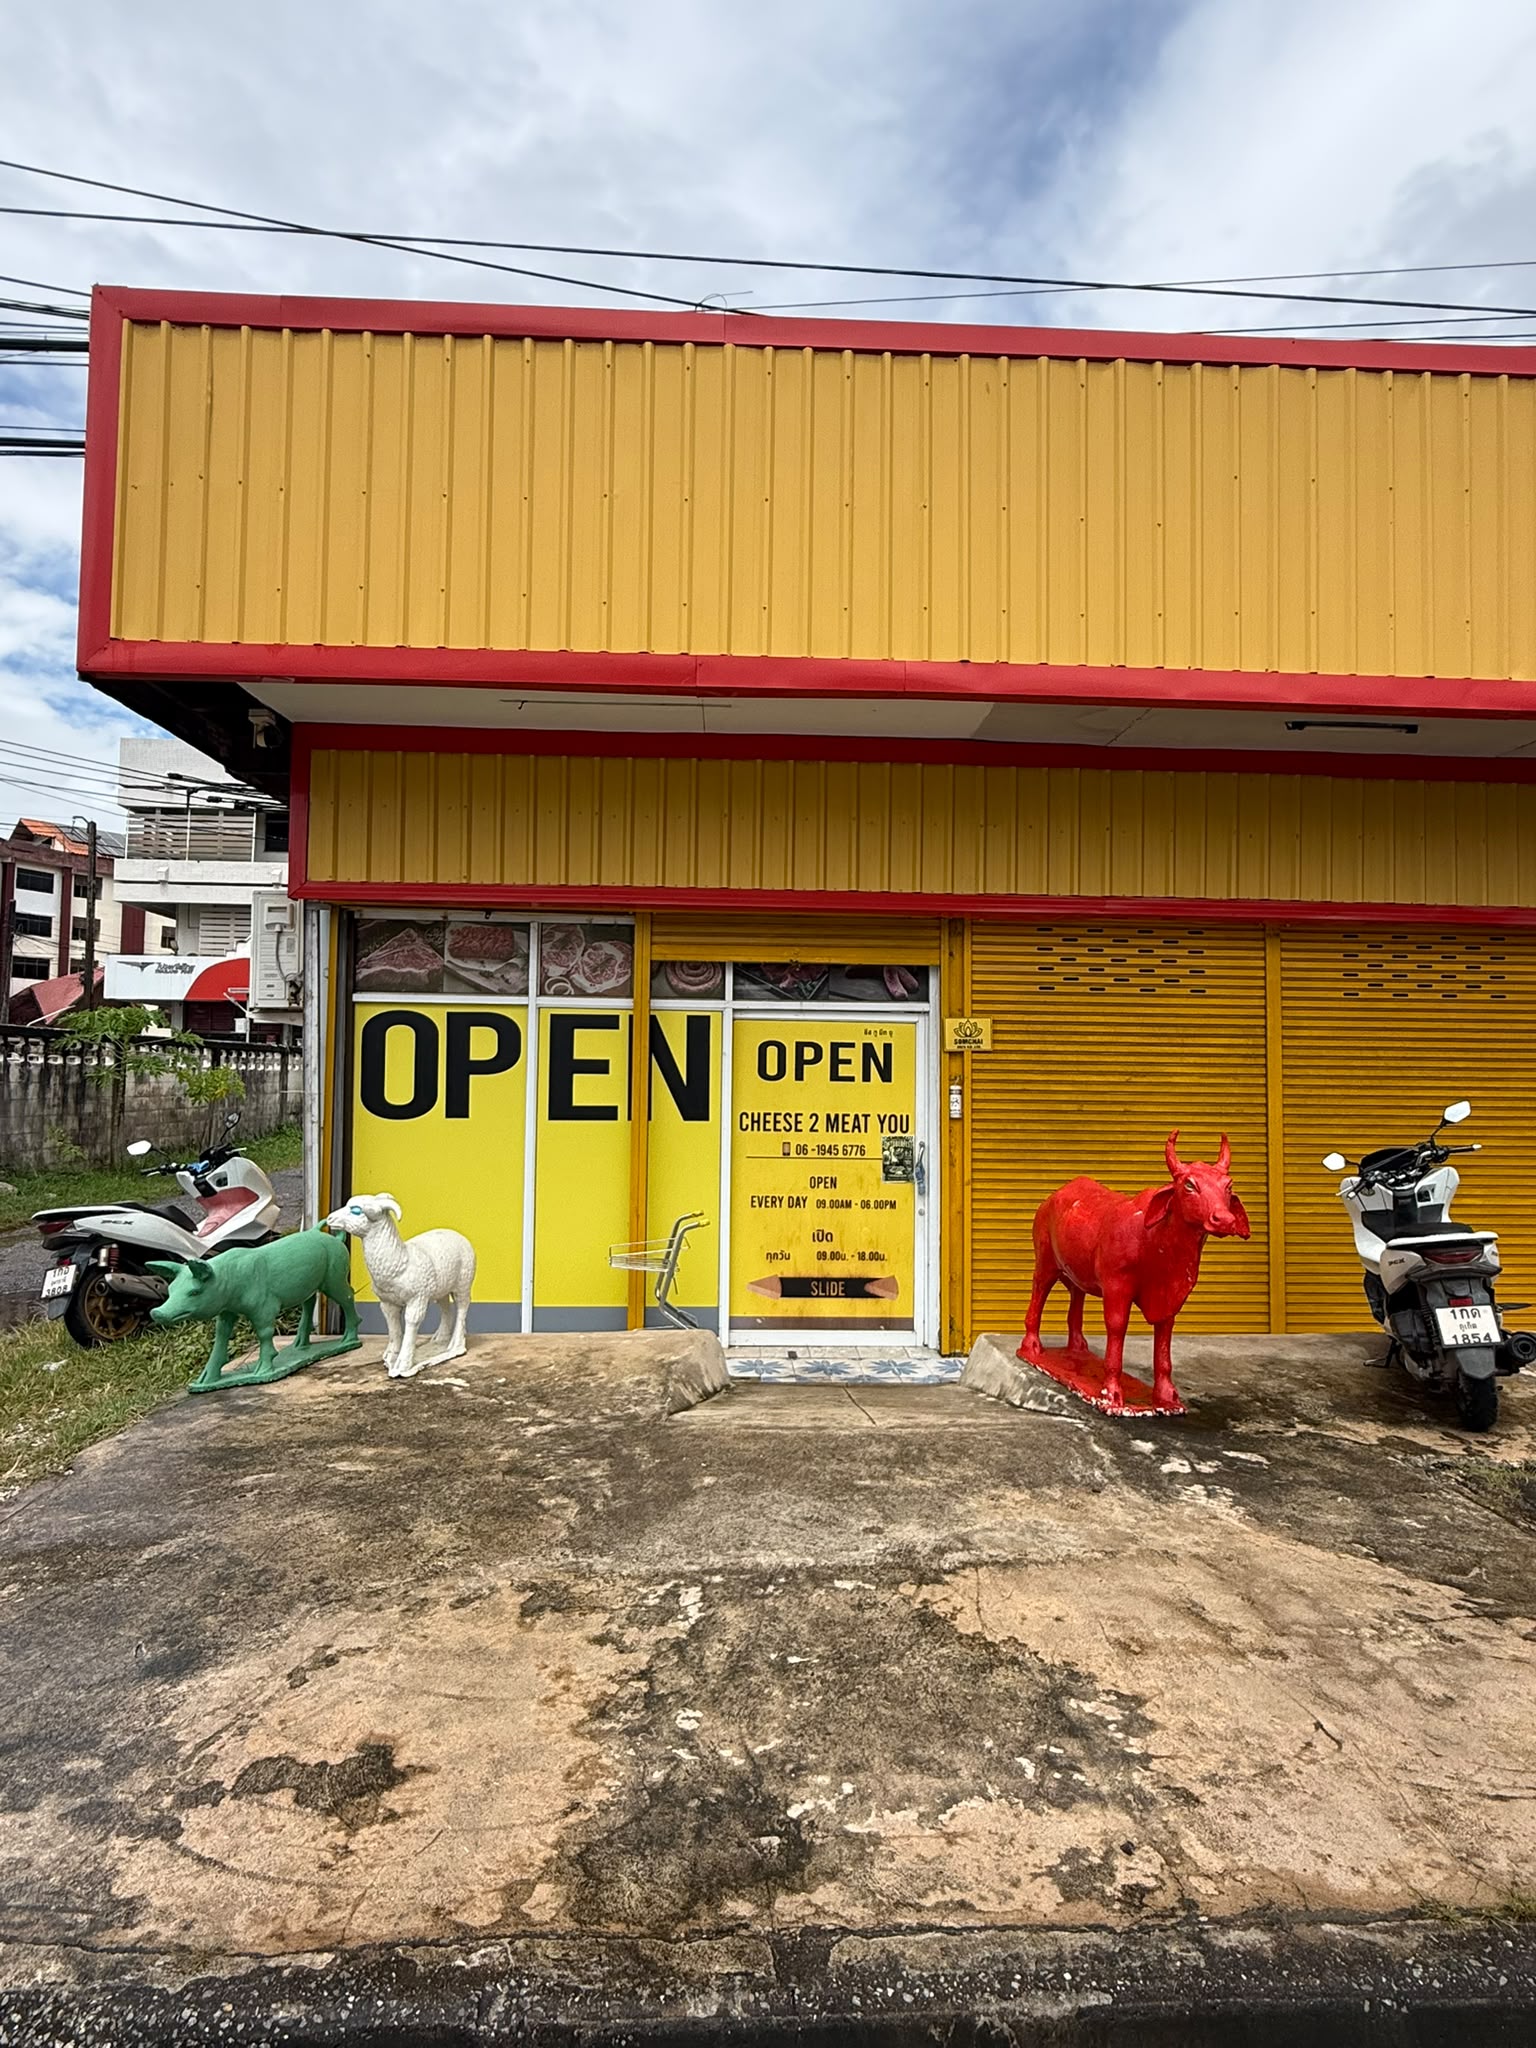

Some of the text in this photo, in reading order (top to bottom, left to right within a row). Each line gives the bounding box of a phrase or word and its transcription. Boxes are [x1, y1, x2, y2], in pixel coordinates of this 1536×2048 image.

[360, 1009, 711, 1122] OPEN
[757, 1040, 893, 1083] OPEN
[739, 1112, 910, 1134] CHEESE 2 MEAT YOU
[795, 1144, 808, 1156] 06
[842, 1144, 866, 1157] 6776
[809, 1176, 837, 1189] OPEN
[751, 1195, 784, 1209] EVERY
[788, 1196, 808, 1209] DAY
[816, 1199, 852, 1209] 09.00AM
[860, 1200, 896, 1210] 06.00PM
[812, 1229, 833, 1243] เปิด
[766, 1250, 791, 1263] ทุกวัน
[811, 1281, 846, 1296] SLIDE
[1450, 1308, 1481, 1320] 1กด
[1451, 1332, 1492, 1345] 1854
